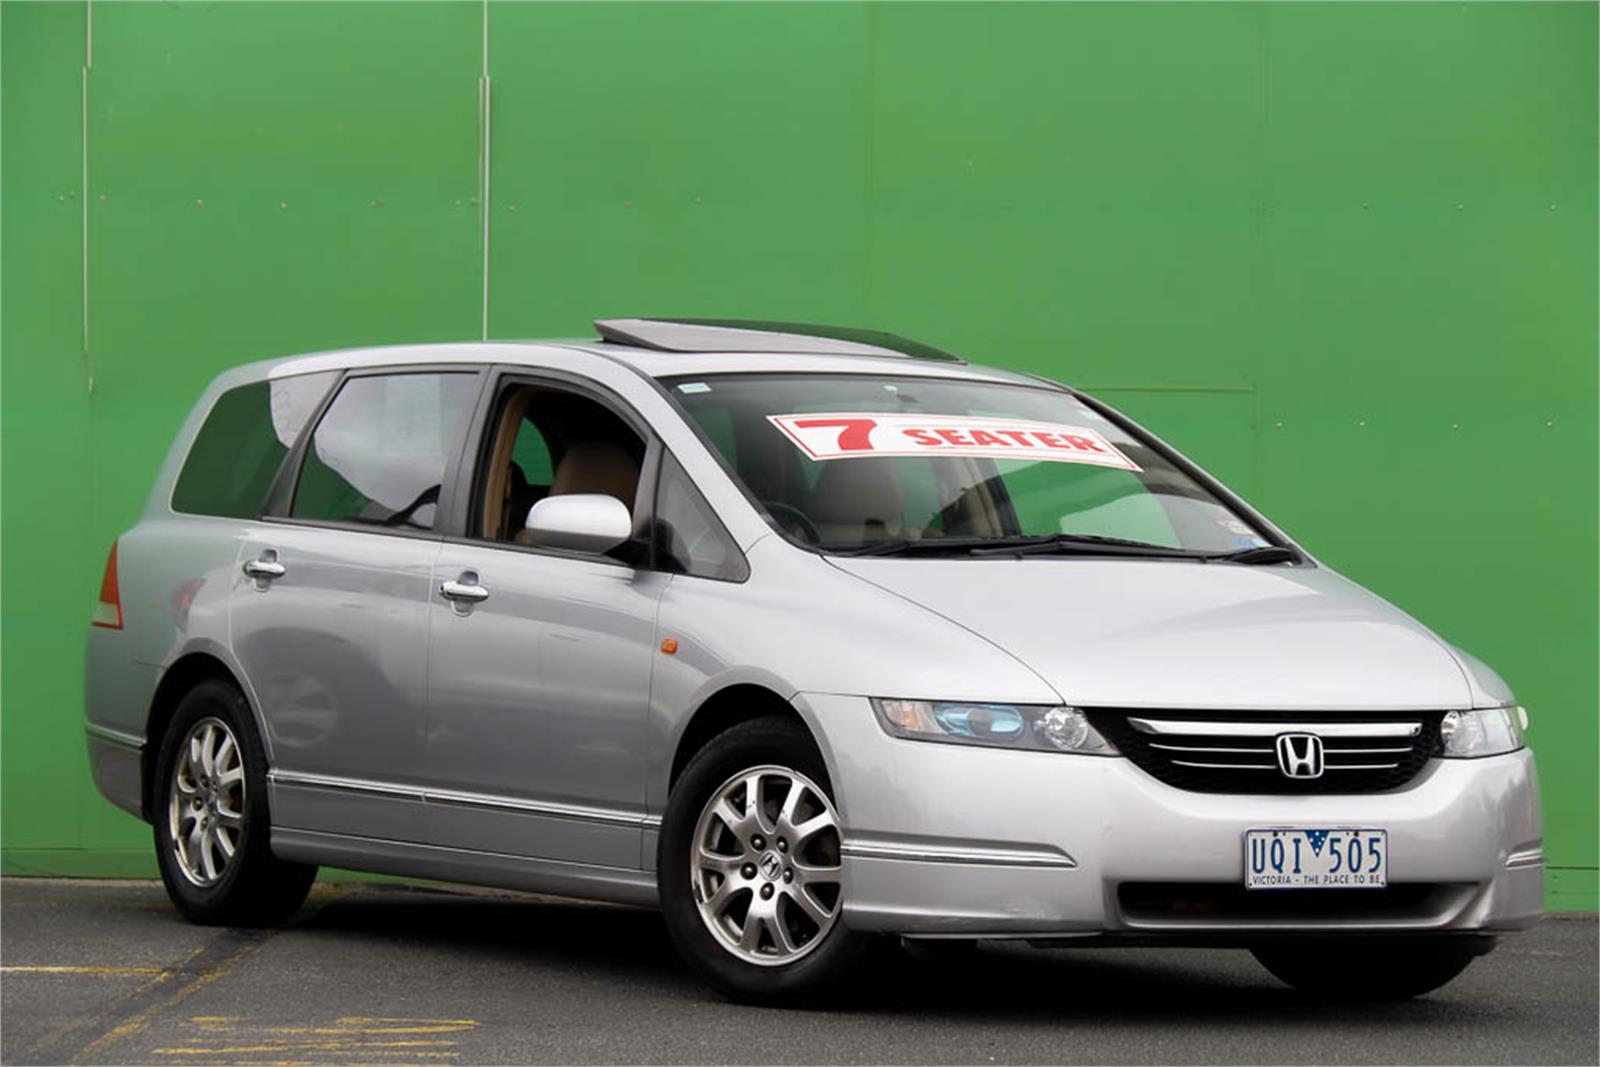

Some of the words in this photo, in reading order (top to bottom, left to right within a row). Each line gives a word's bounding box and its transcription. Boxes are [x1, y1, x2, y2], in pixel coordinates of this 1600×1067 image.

[794, 419, 877, 450] 7
[901, 428, 1105, 452] SEATER
[1252, 838, 1301, 874] UQI
[1329, 838, 1382, 873] 505
[1252, 875, 1291, 885] VICTORIA
[1304, 875, 1319, 884] THE
[1324, 875, 1349, 884] PLACE
[1354, 875, 1365, 884] TO
